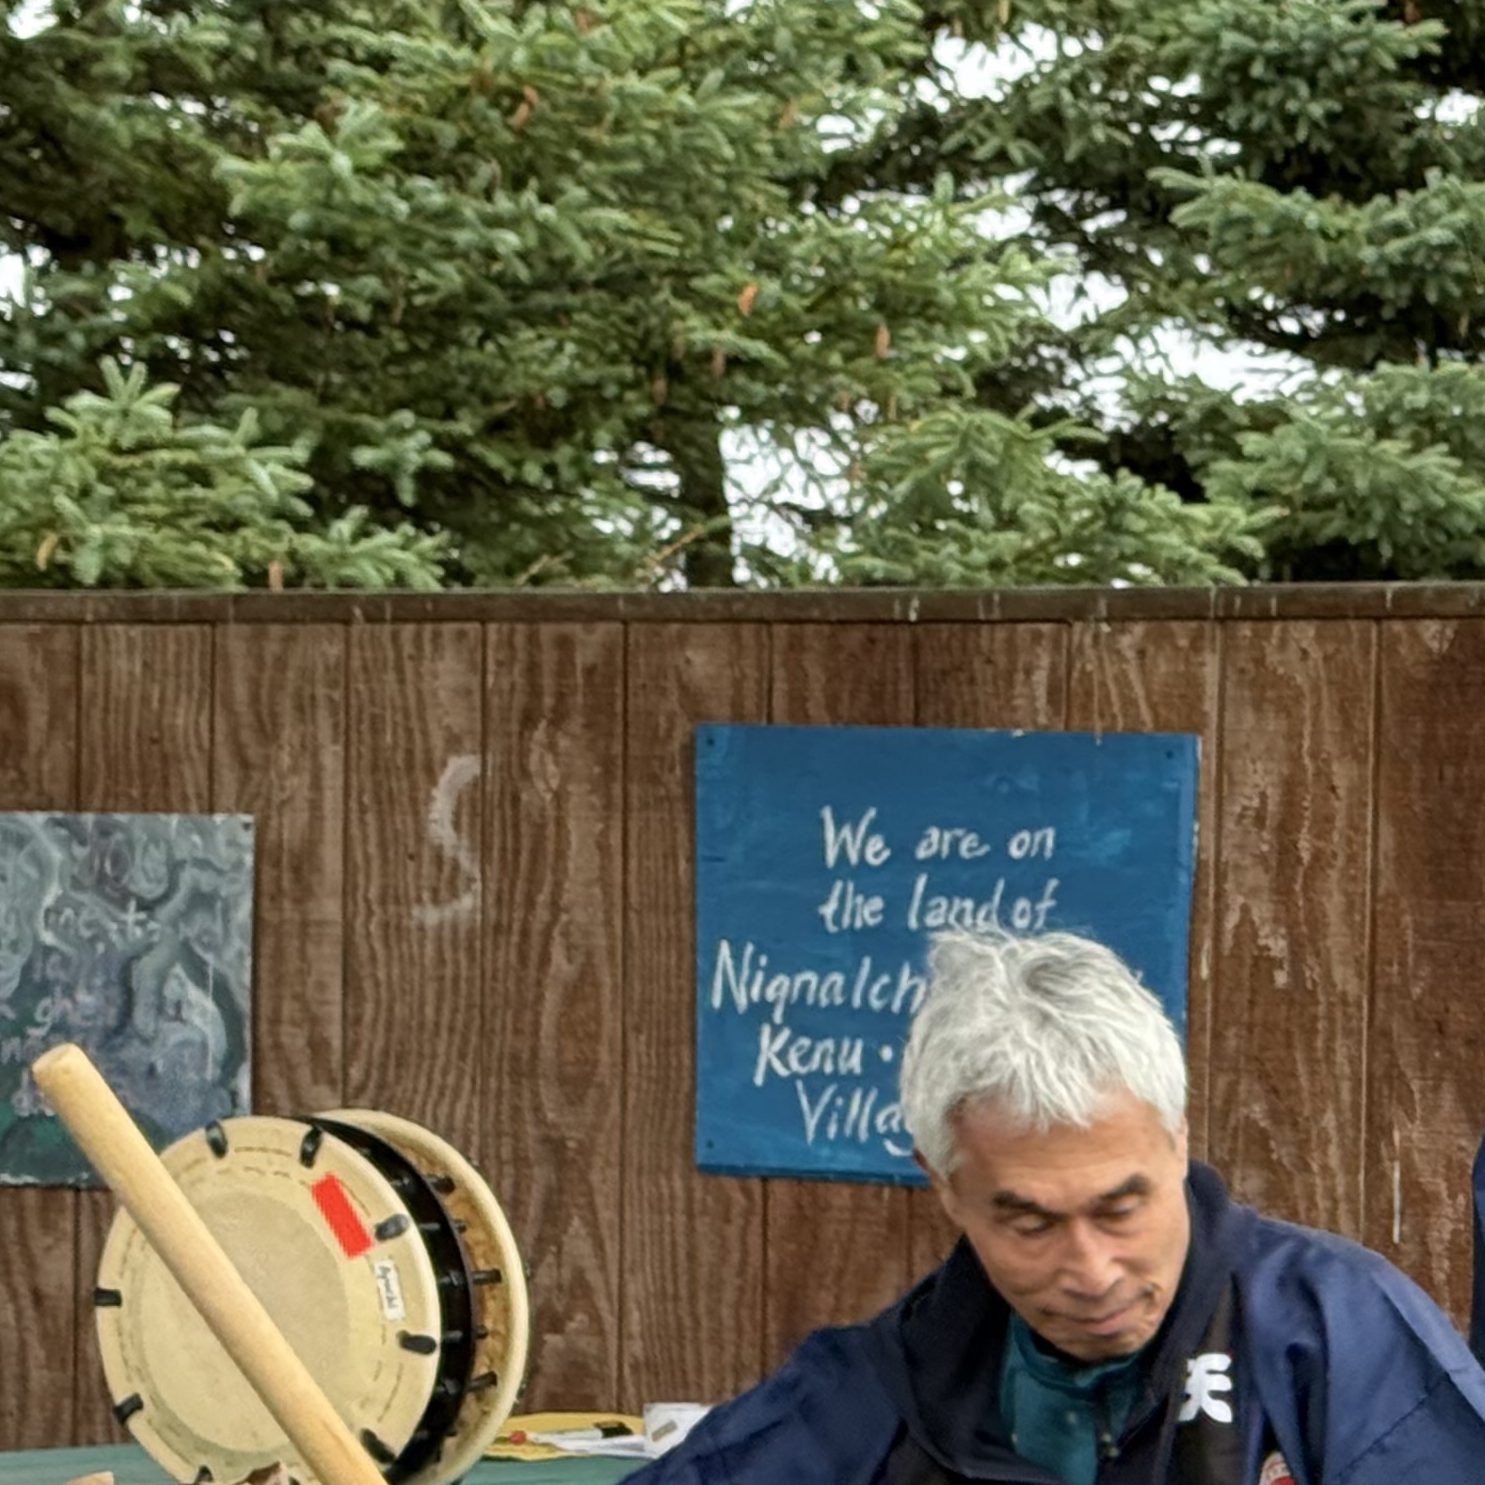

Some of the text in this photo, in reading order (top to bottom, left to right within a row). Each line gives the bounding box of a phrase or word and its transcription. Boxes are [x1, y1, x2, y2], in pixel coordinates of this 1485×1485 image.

[821, 805, 1055, 868] We are on
[818, 873, 1060, 933] the land of
